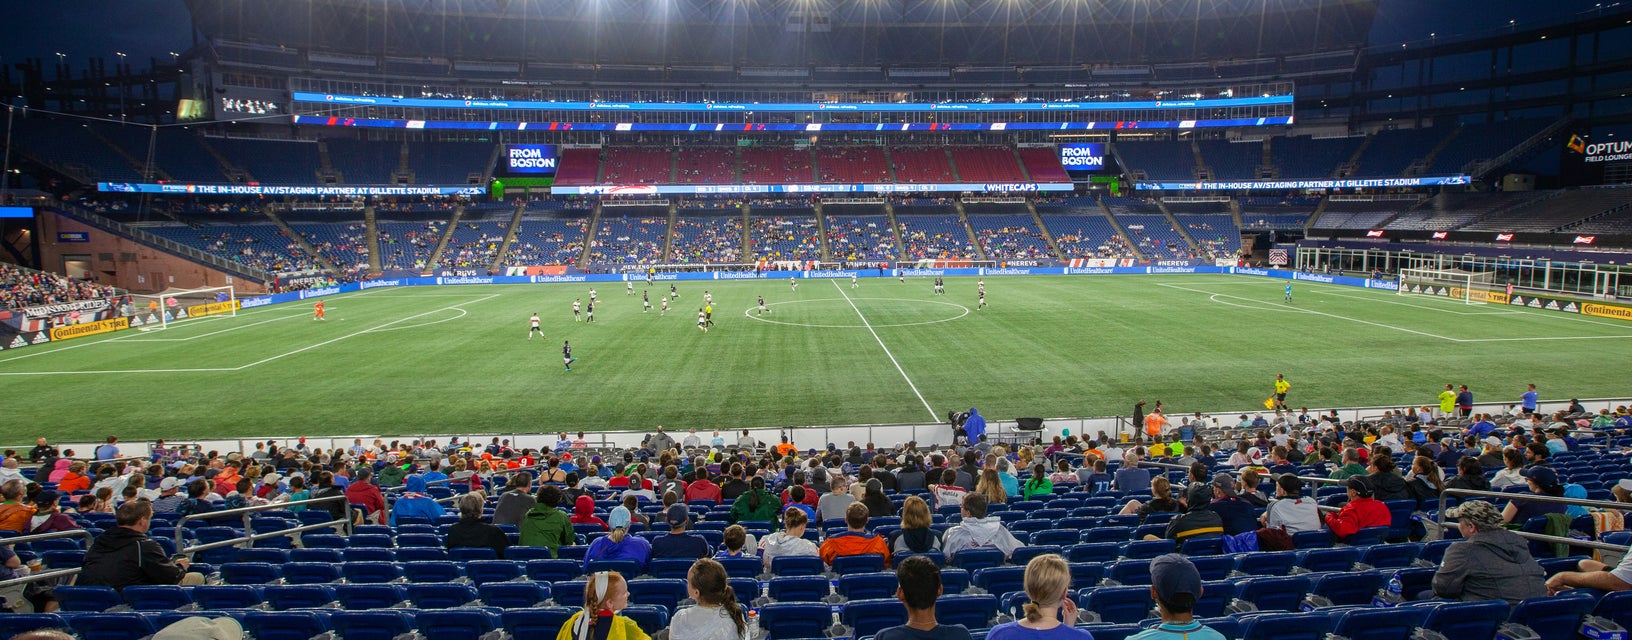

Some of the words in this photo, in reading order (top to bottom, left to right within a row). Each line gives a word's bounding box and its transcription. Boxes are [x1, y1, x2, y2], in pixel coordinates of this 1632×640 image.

[1062, 147, 1090, 156] FROM
[1586, 141, 1632, 155] OPTUM
[509, 149, 541, 158] FROM
[510, 158, 555, 168] BOSTON
[1062, 156, 1102, 166] BOSTON
[1253, 181, 1298, 189] AV/STAGING
[1299, 180, 1333, 188] PARTNER
[1347, 179, 1383, 187] GILLETTE
[1384, 178, 1420, 186] STADIUM
[197, 185, 217, 193] THE
[218, 185, 261, 194] IN-HOUSE
[263, 186, 316, 194] AV/STAGING
[317, 186, 356, 195] PARTNER
[369, 187, 406, 195] GILLETTE
[407, 187, 440, 195] STADIUM
[444, 276, 494, 284] UnitedHealthcare
[538, 274, 586, 282] UnitedHealthcare
[54, 323, 101, 340] Continental
[1095, 481, 1110, 492] 77
